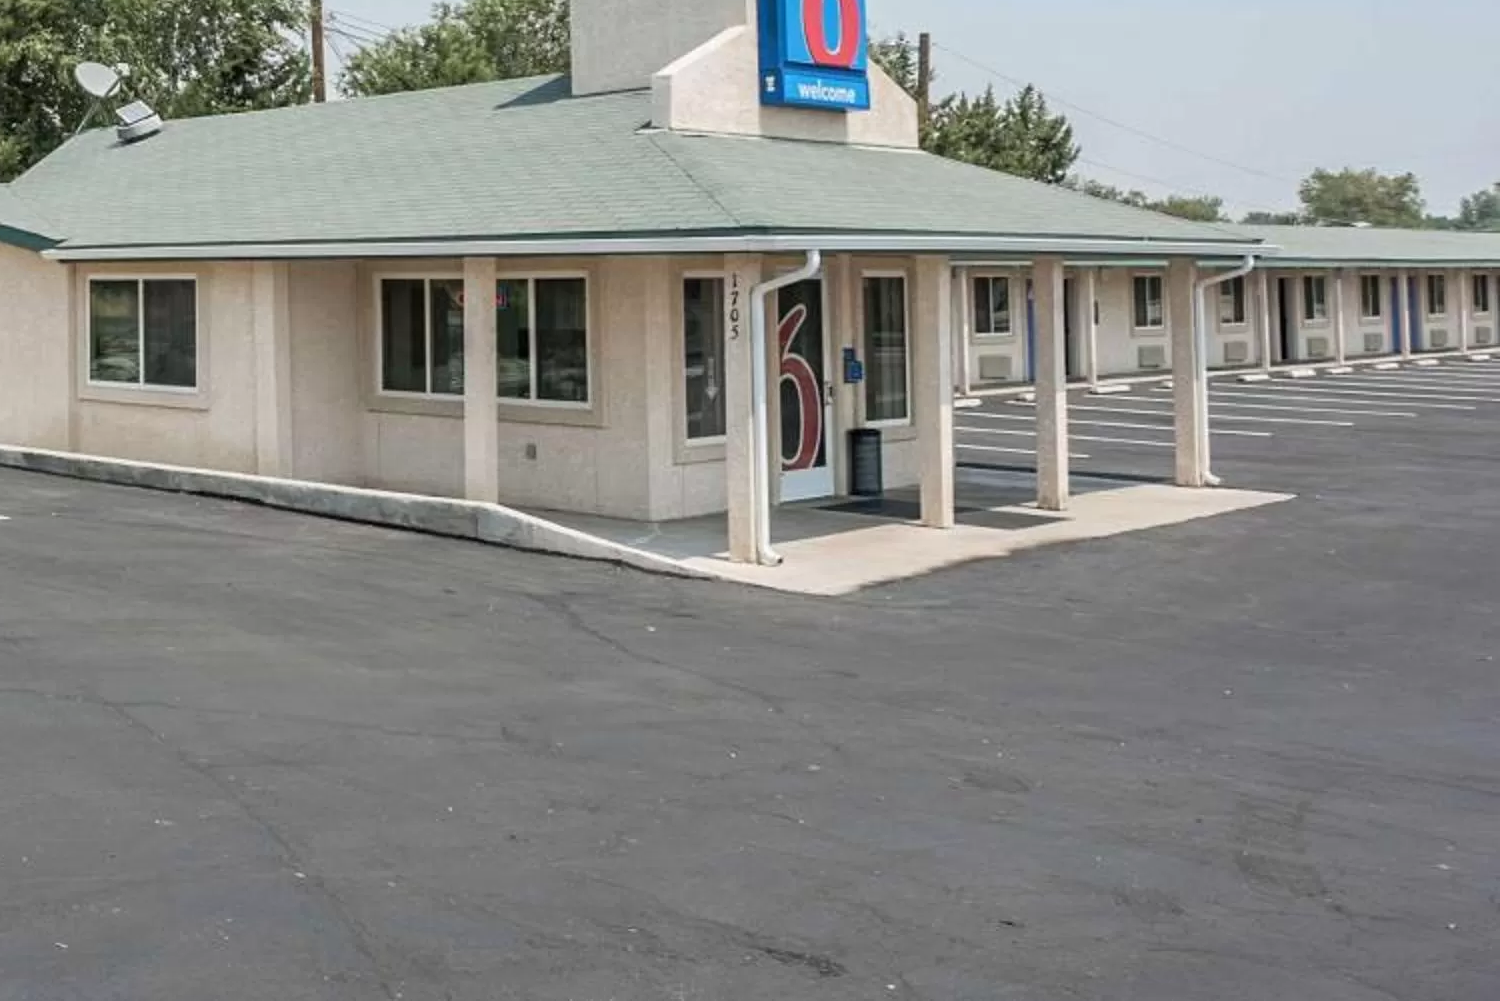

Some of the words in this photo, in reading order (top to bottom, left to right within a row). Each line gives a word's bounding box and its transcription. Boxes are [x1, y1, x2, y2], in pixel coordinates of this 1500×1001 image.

[797, 79, 856, 103] welcome
[730, 272, 739, 340] 1705
[778, 303, 823, 471] 6
